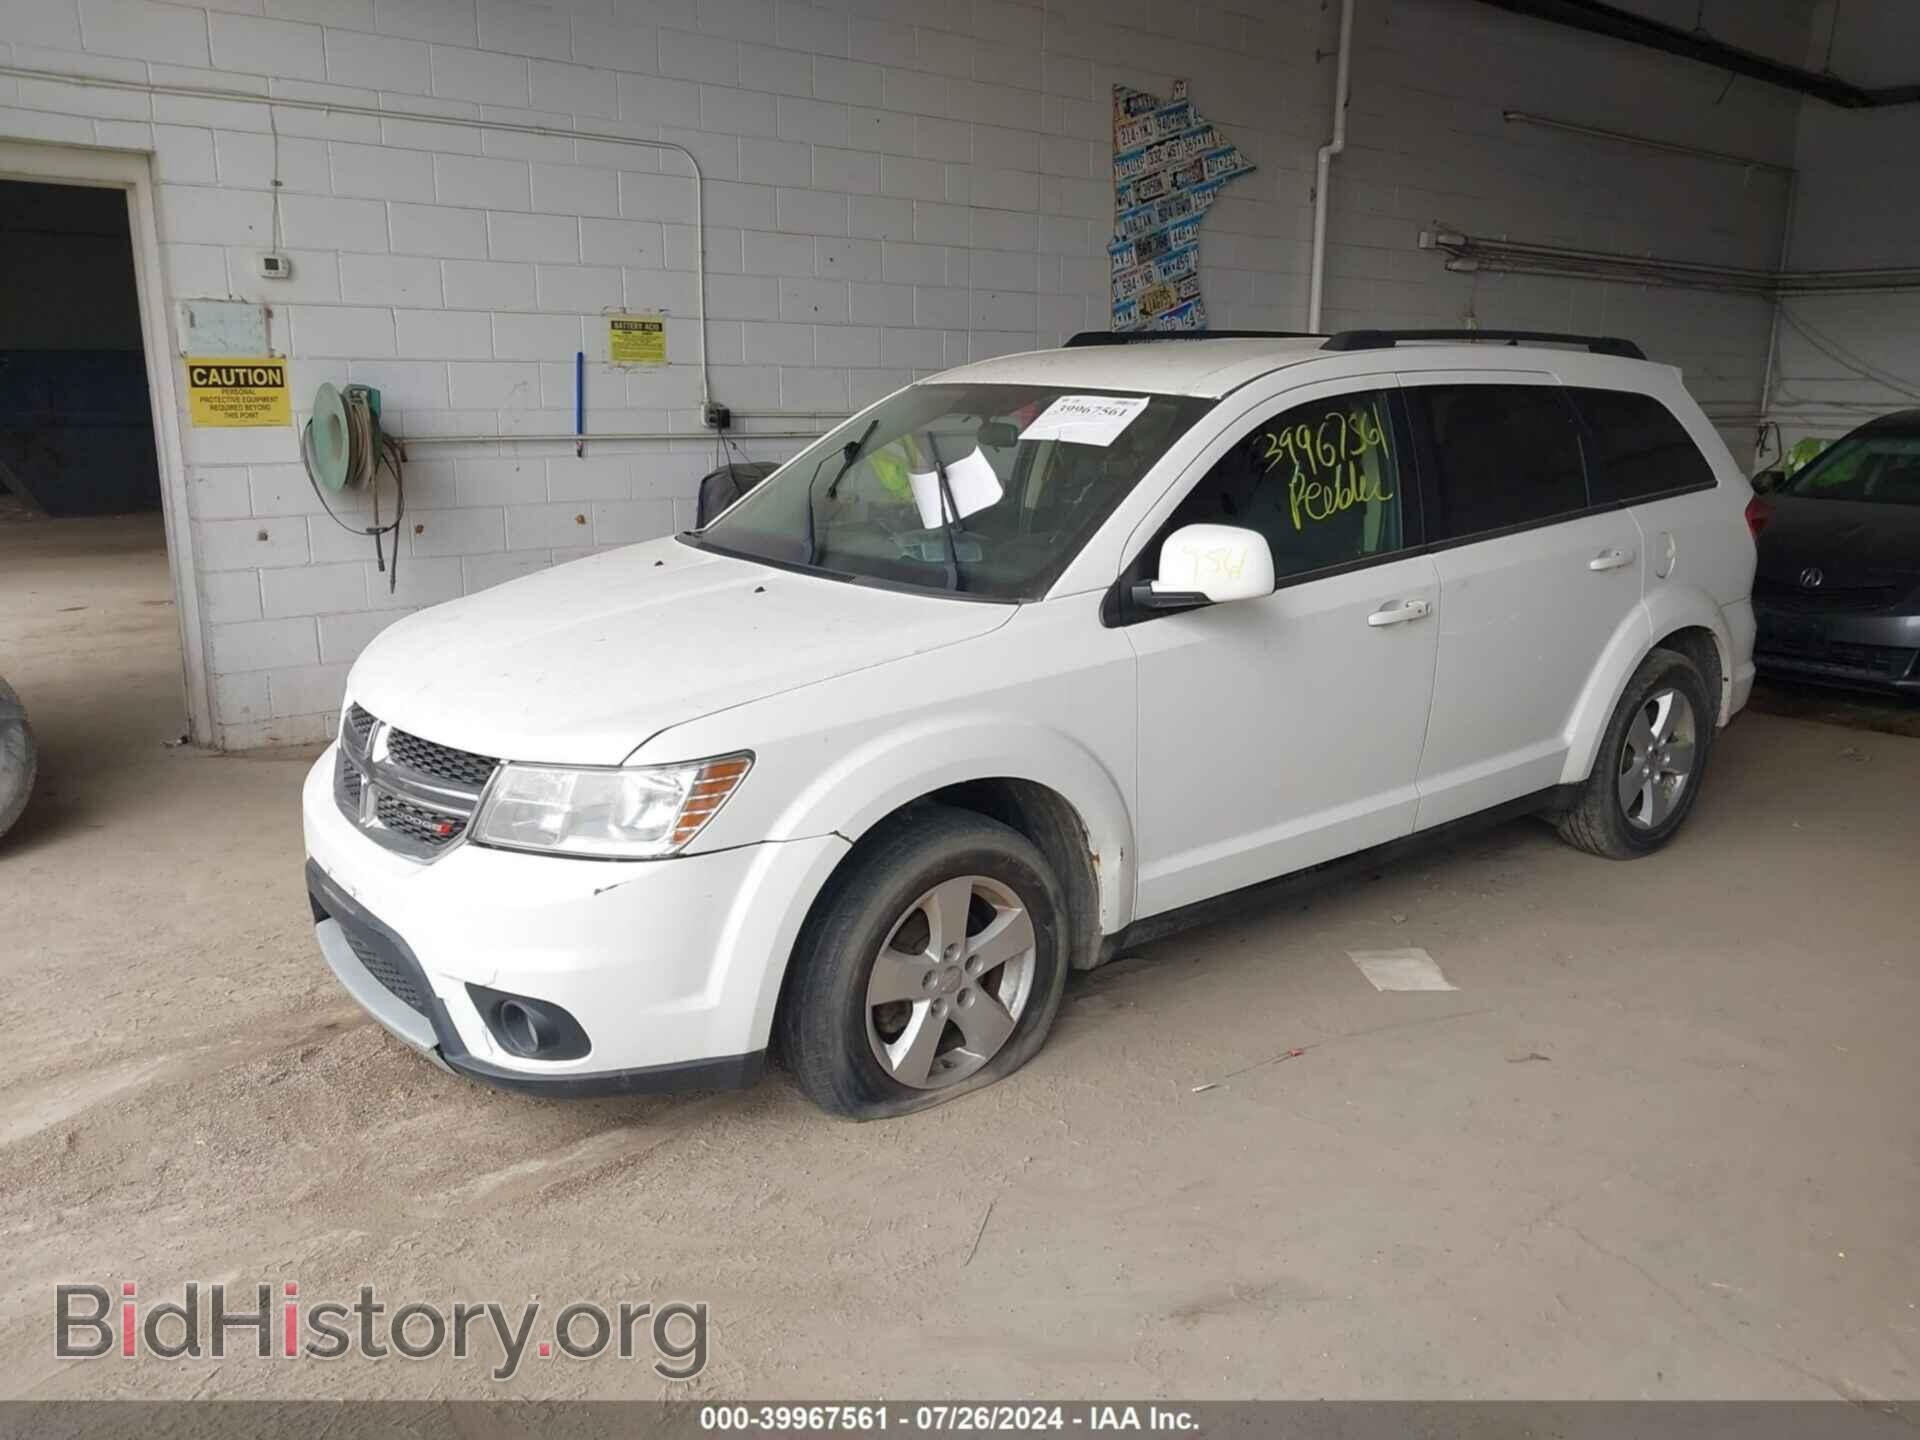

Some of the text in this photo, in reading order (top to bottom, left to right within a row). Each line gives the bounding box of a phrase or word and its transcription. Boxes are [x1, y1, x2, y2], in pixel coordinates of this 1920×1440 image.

[613, 322, 643, 330] BATTERY
[193, 368, 281, 386] CAUTION
[1264, 402, 1389, 475] 39967561
